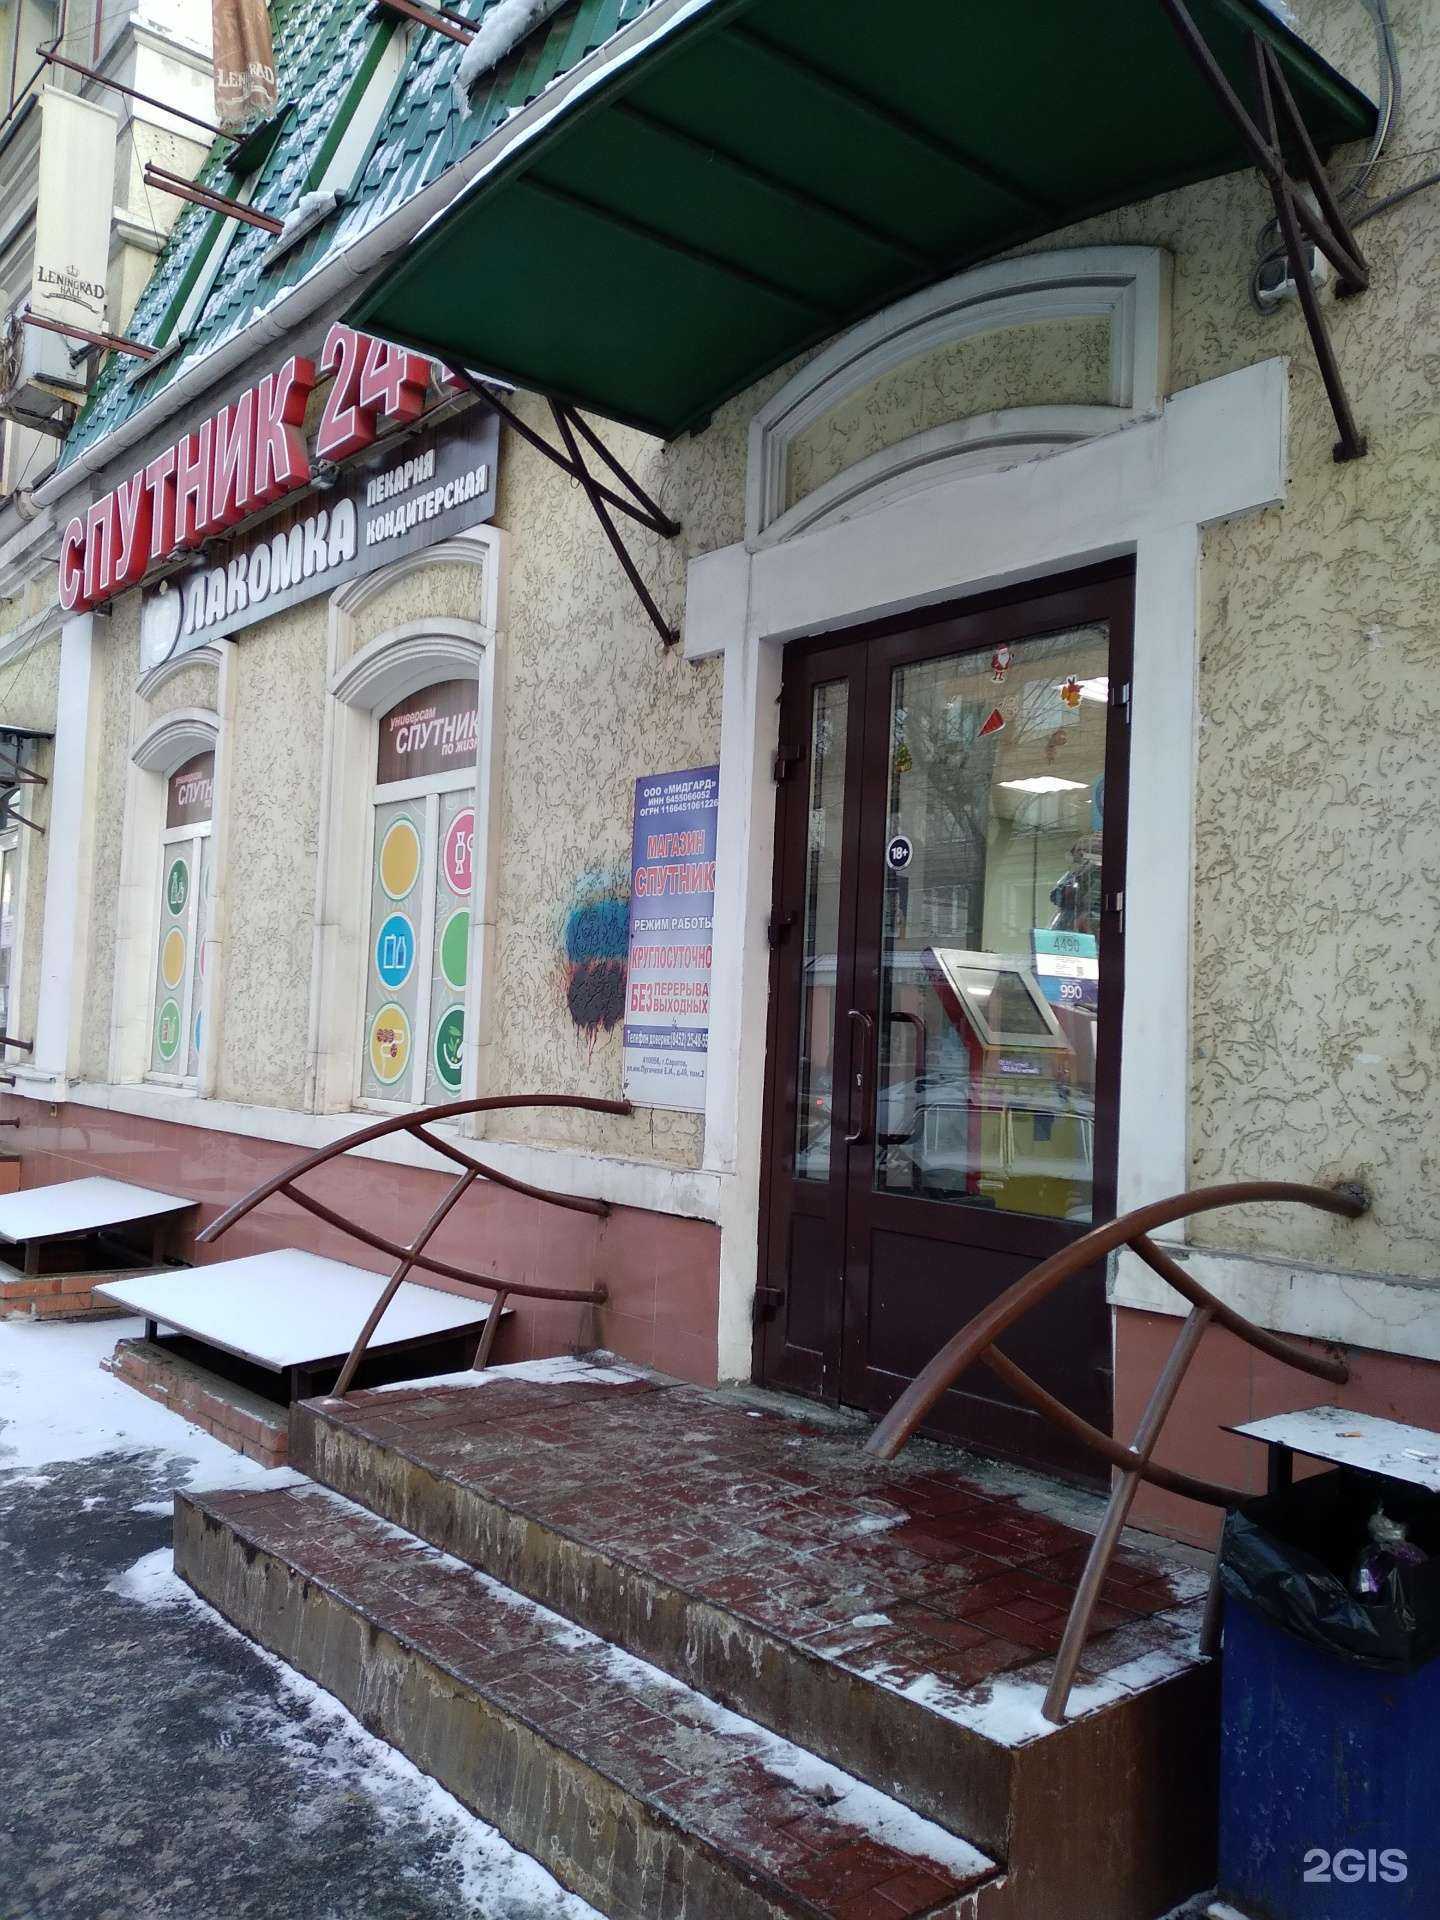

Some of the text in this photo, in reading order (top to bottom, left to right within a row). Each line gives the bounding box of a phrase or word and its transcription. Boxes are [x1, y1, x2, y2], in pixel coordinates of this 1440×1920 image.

[37, 265, 105, 299] LENINGRAD
[60, 286, 80, 298] HALL
[59, 355, 302, 612] СПУТНИК
[366, 448, 435, 508] ПЕКАРНЯ
[366, 464, 489, 546] КОНДИТЕРСКАЯ
[182, 498, 358, 636] ЛАКОМКА
[396, 710, 479, 754] СПУТНИК
[643, 779, 717, 798] ООО «МИДГАРД»
[647, 797, 665, 807] ИНН
[639, 806, 660, 817] ОГРН
[647, 829, 706, 860] МАГАЗИН
[891, 846, 909, 860] 18+
[634, 860, 716, 898] СПУТНИК
[634, 918, 669, 932] РЕЖИМ
[631, 945, 712, 969] КРУГЛОСУТОЧНО
[630, 982, 710, 1012] БЕЗ ПЕРЕРЫВА
[1060, 984, 1083, 999] 990
[653, 998, 708, 1015] ВЫХОДНЫХ
